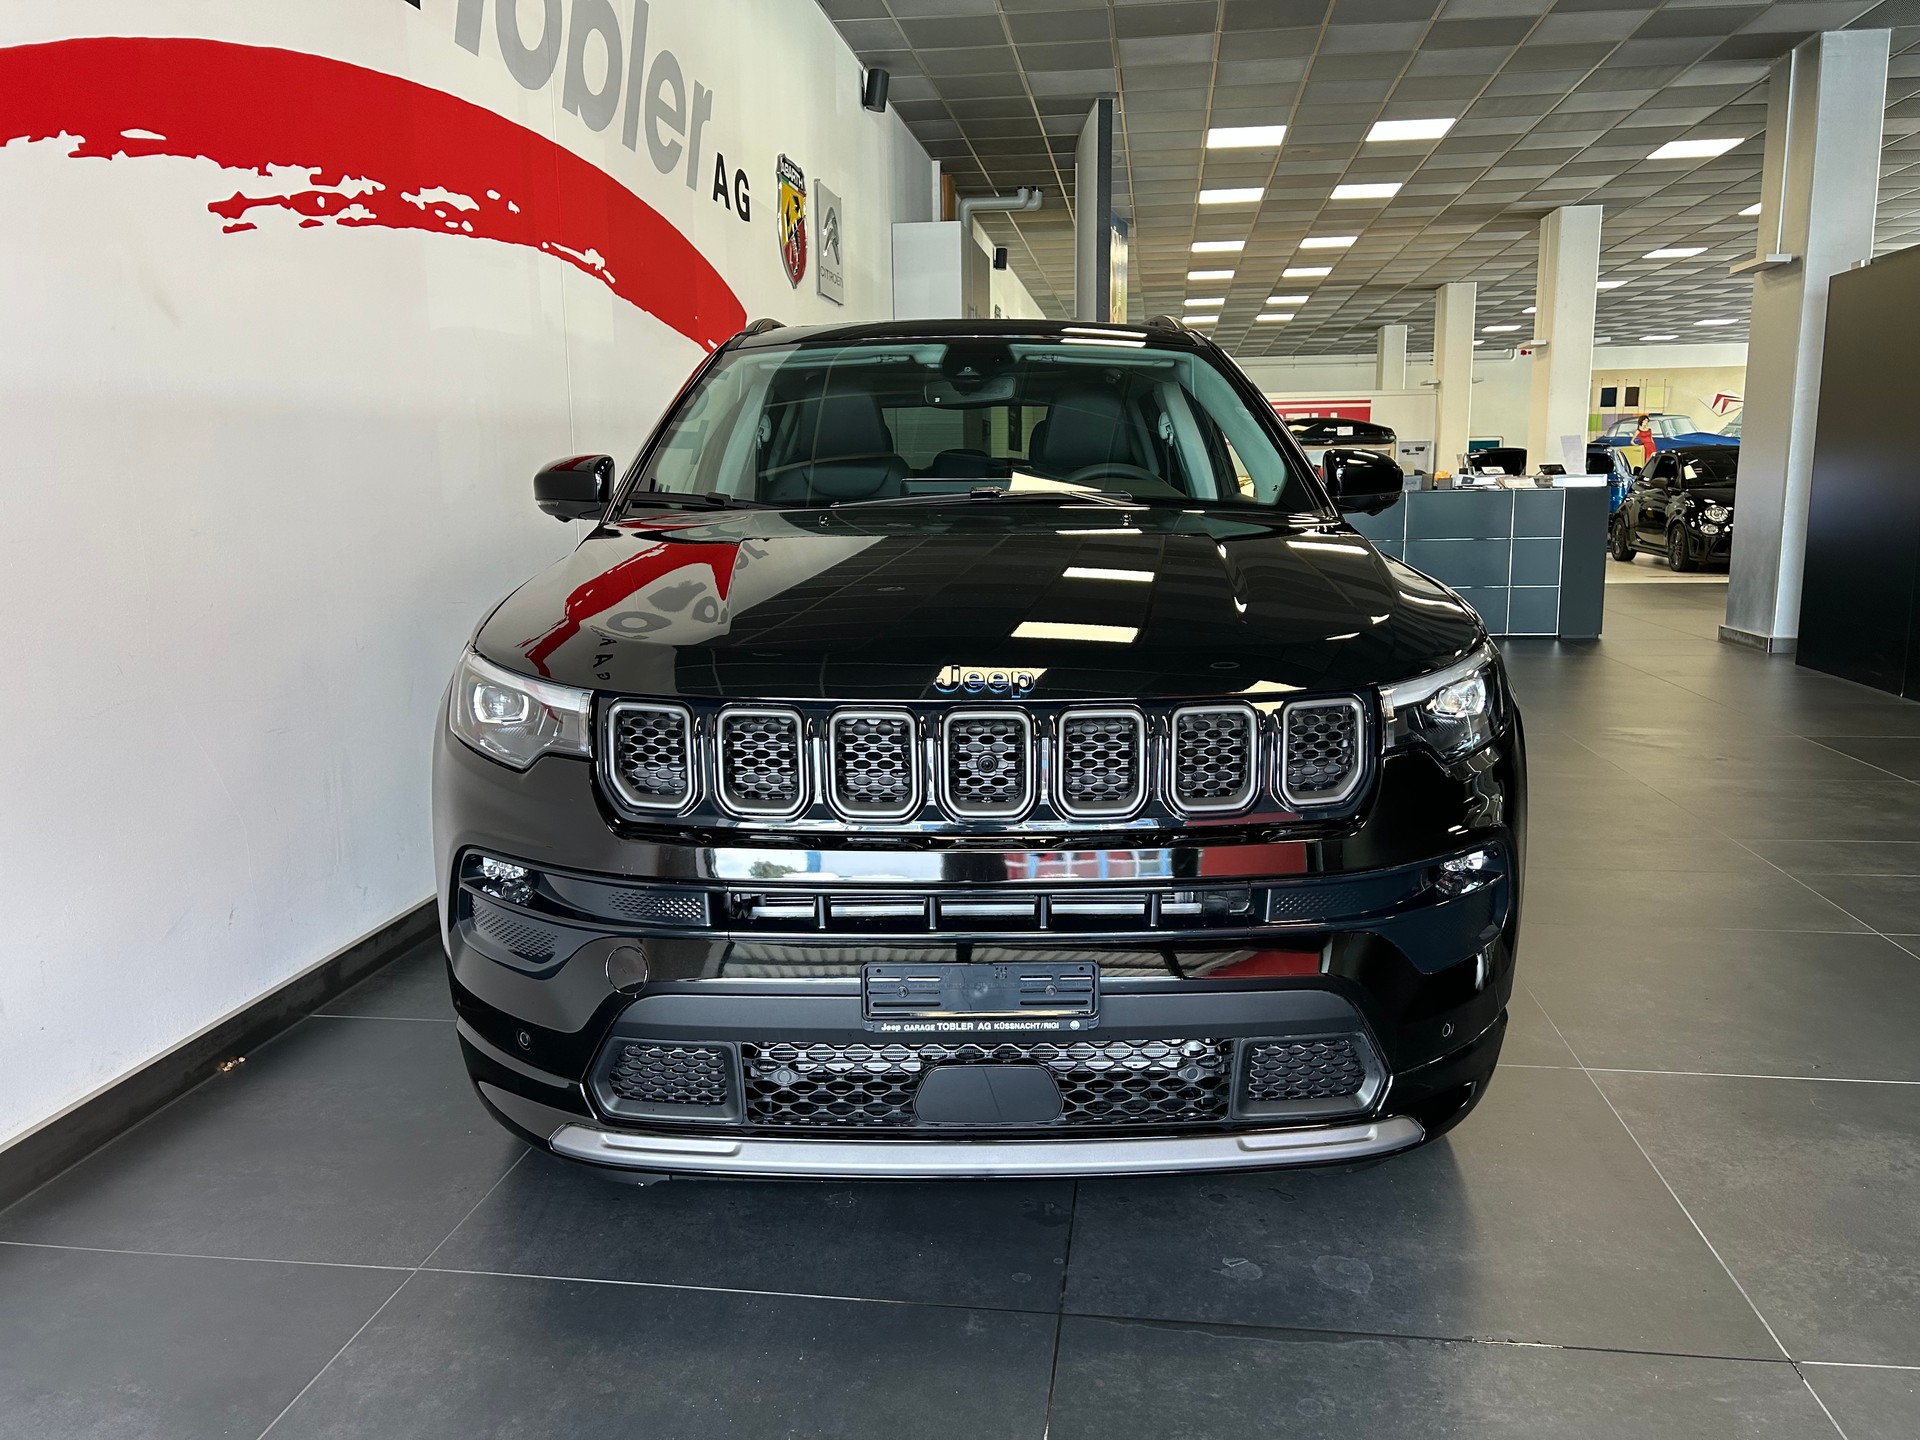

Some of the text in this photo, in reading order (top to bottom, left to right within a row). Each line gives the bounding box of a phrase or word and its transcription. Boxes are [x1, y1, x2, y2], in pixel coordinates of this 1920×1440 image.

[712, 152, 751, 222] AG
[780, 162, 803, 189] ABARTH
[934, 664, 1035, 699] Jeep
[880, 1021, 1060, 1032] Jeep GARAGE TOBLER AG KÜSSNACHT/RIGI
